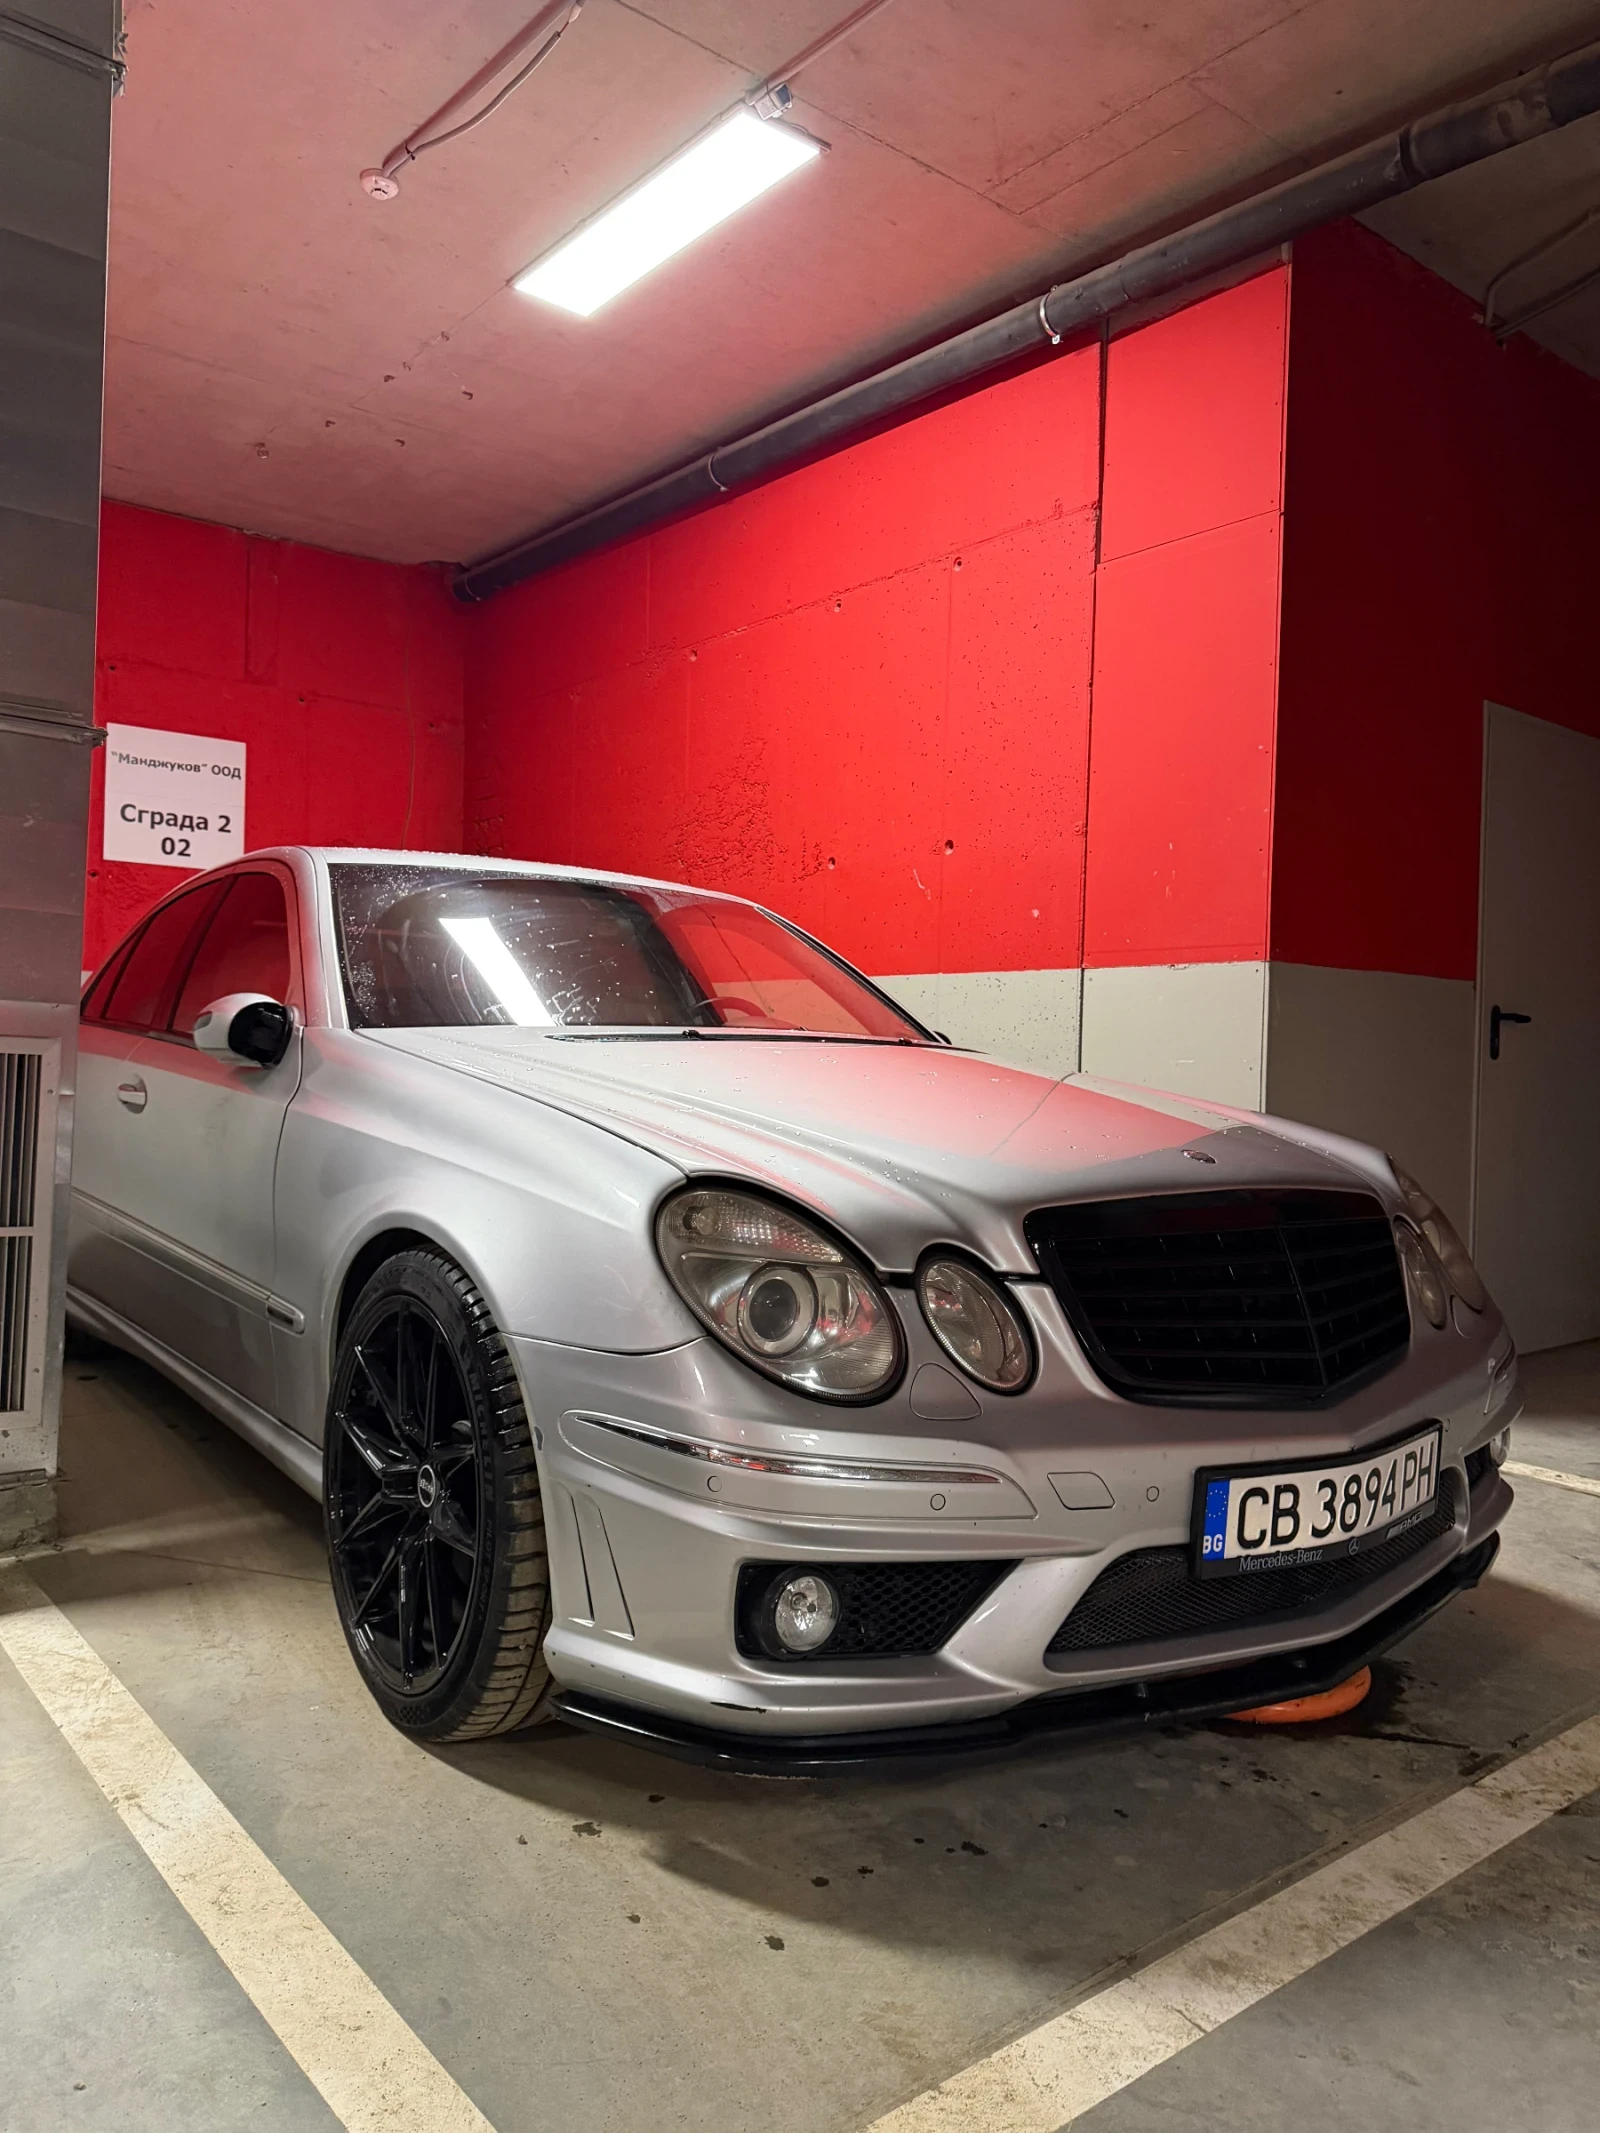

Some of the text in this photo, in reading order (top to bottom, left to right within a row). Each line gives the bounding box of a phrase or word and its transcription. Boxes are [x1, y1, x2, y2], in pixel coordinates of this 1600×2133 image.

[211, 764, 242, 780] ООД
[120, 803, 232, 833] Сграда 2
[161, 837, 192, 857] 02
[468, 1373, 495, 1501] MICHELIN
[1237, 1442, 1434, 1549] CB 3894 PH
[1203, 1533, 1223, 1554] BG
[1239, 1549, 1323, 1573] Mercedes-Benz
